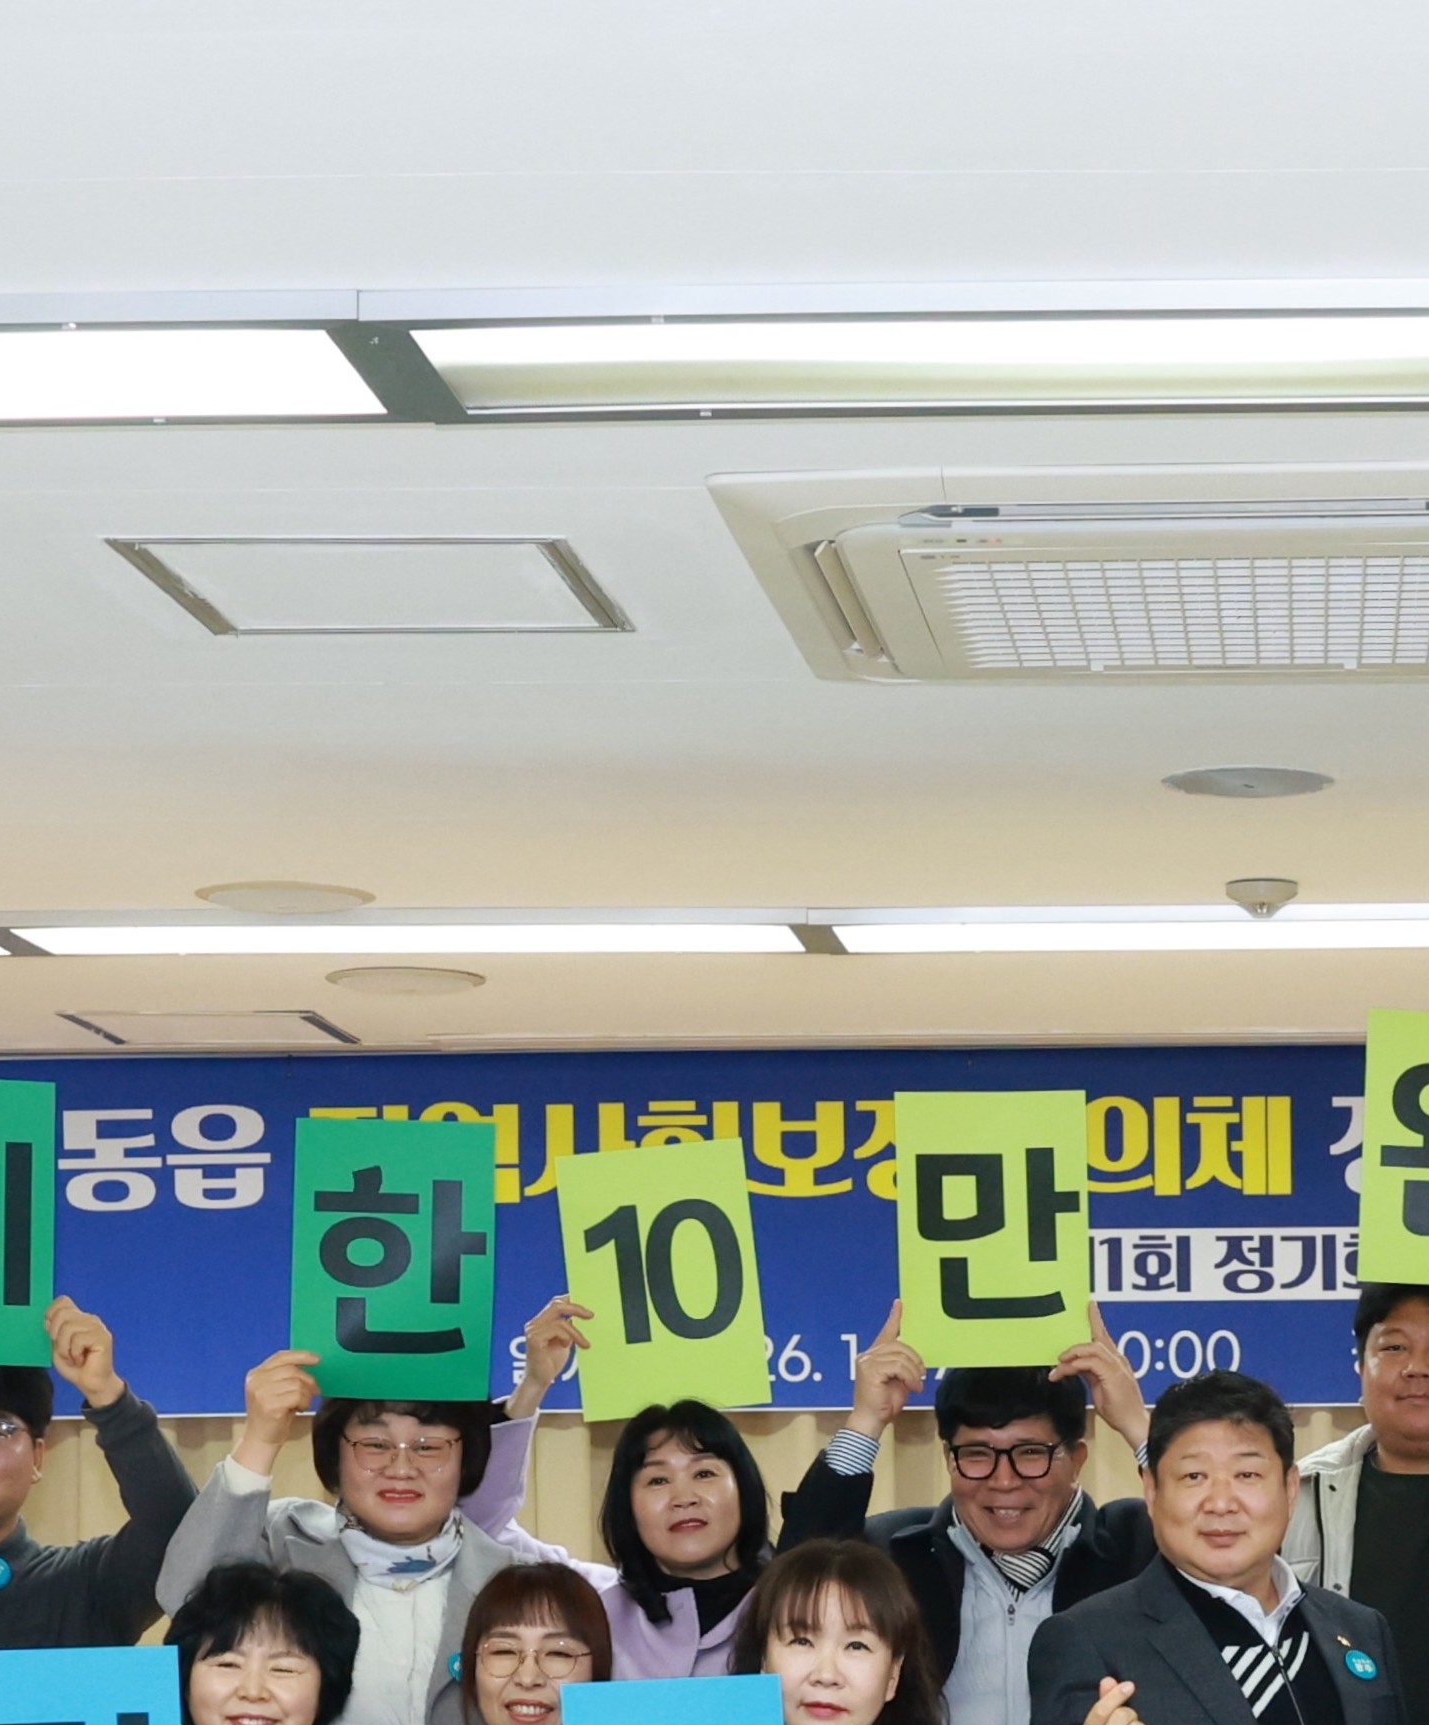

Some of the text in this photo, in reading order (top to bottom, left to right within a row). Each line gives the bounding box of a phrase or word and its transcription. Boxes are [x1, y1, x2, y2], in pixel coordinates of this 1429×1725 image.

[314, 1166, 486, 1354] 한
[585, 1199, 742, 1344] 10
[916, 1148, 1079, 1319] 만
